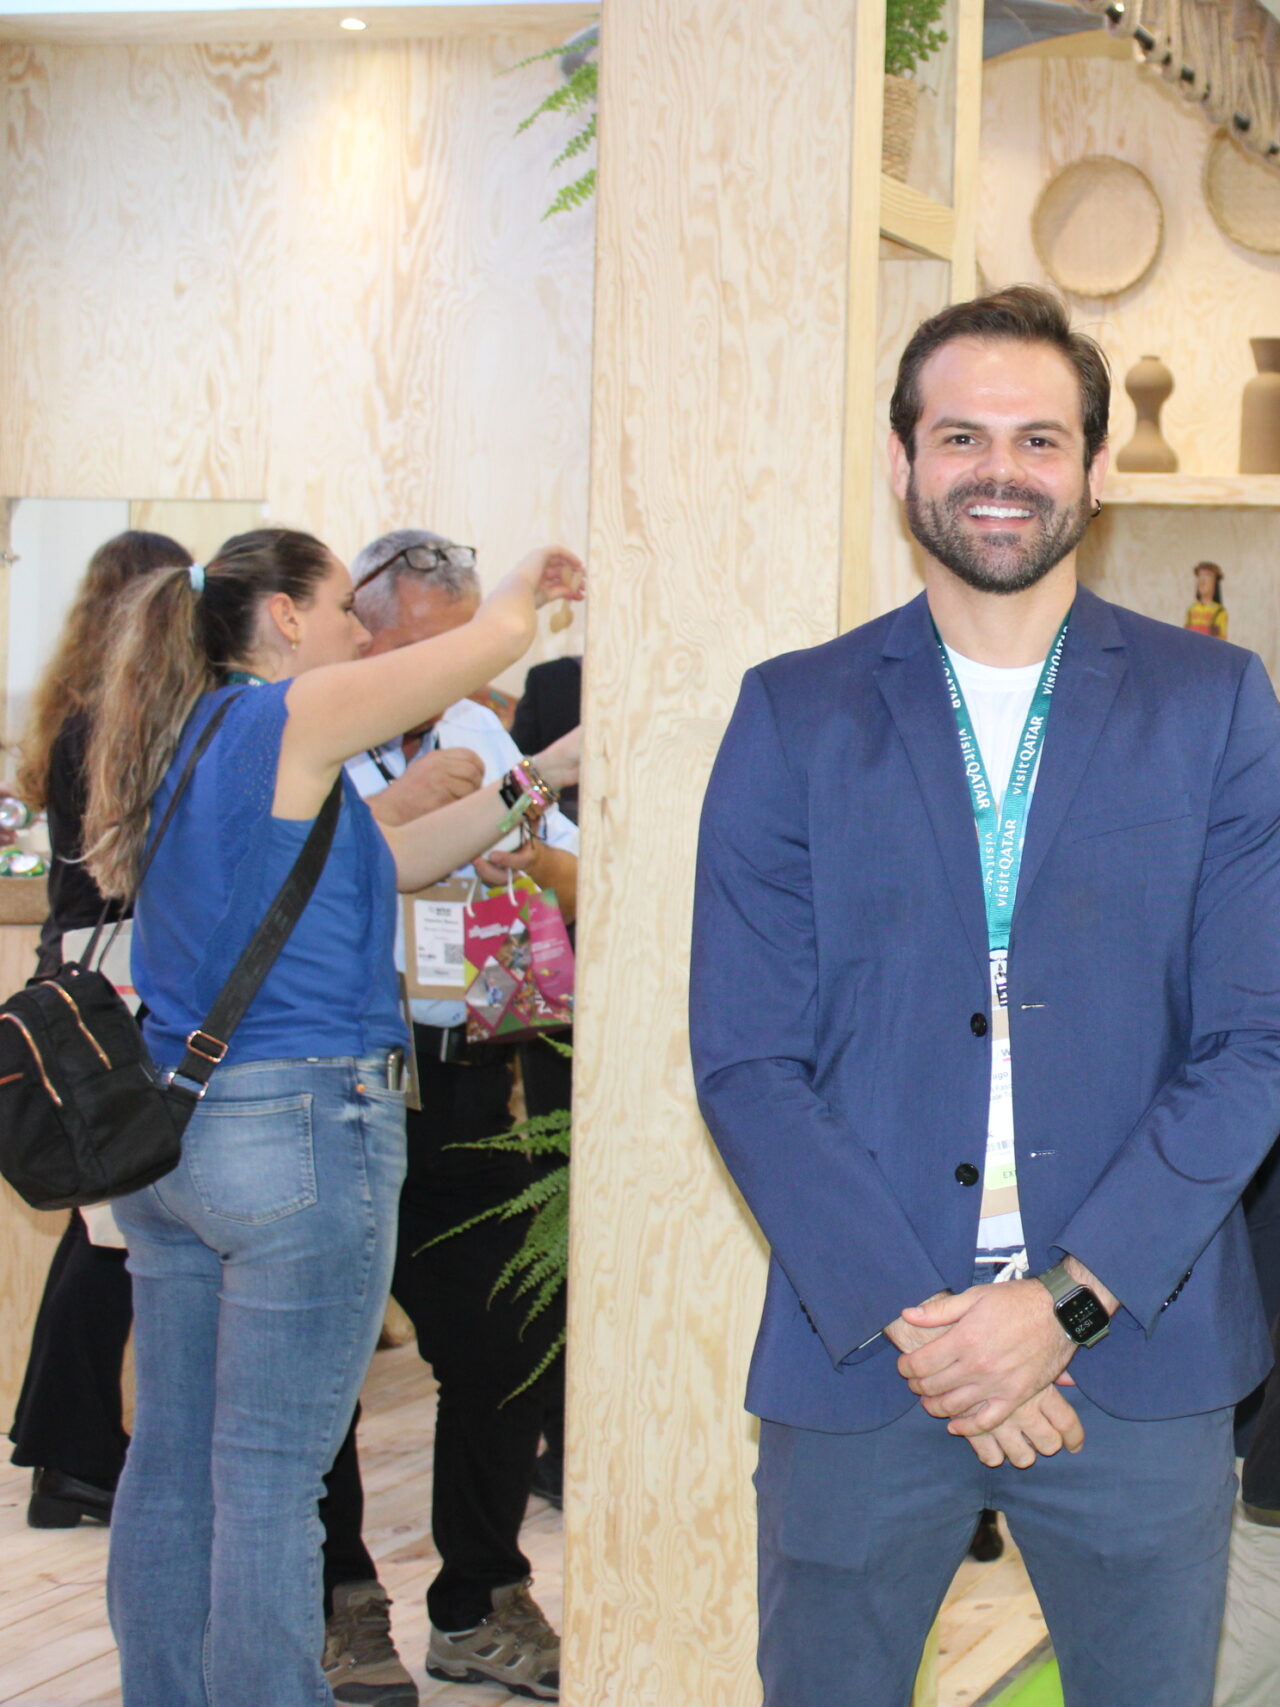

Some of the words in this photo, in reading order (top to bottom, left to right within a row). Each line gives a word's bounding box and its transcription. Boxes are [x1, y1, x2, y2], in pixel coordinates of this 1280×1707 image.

[1043, 626, 1068, 695] visitQAT
[958, 728, 991, 810] visitQATAR
[1012, 715, 1044, 795] visitQATAR
[995, 819, 1017, 907] visitQATAR
